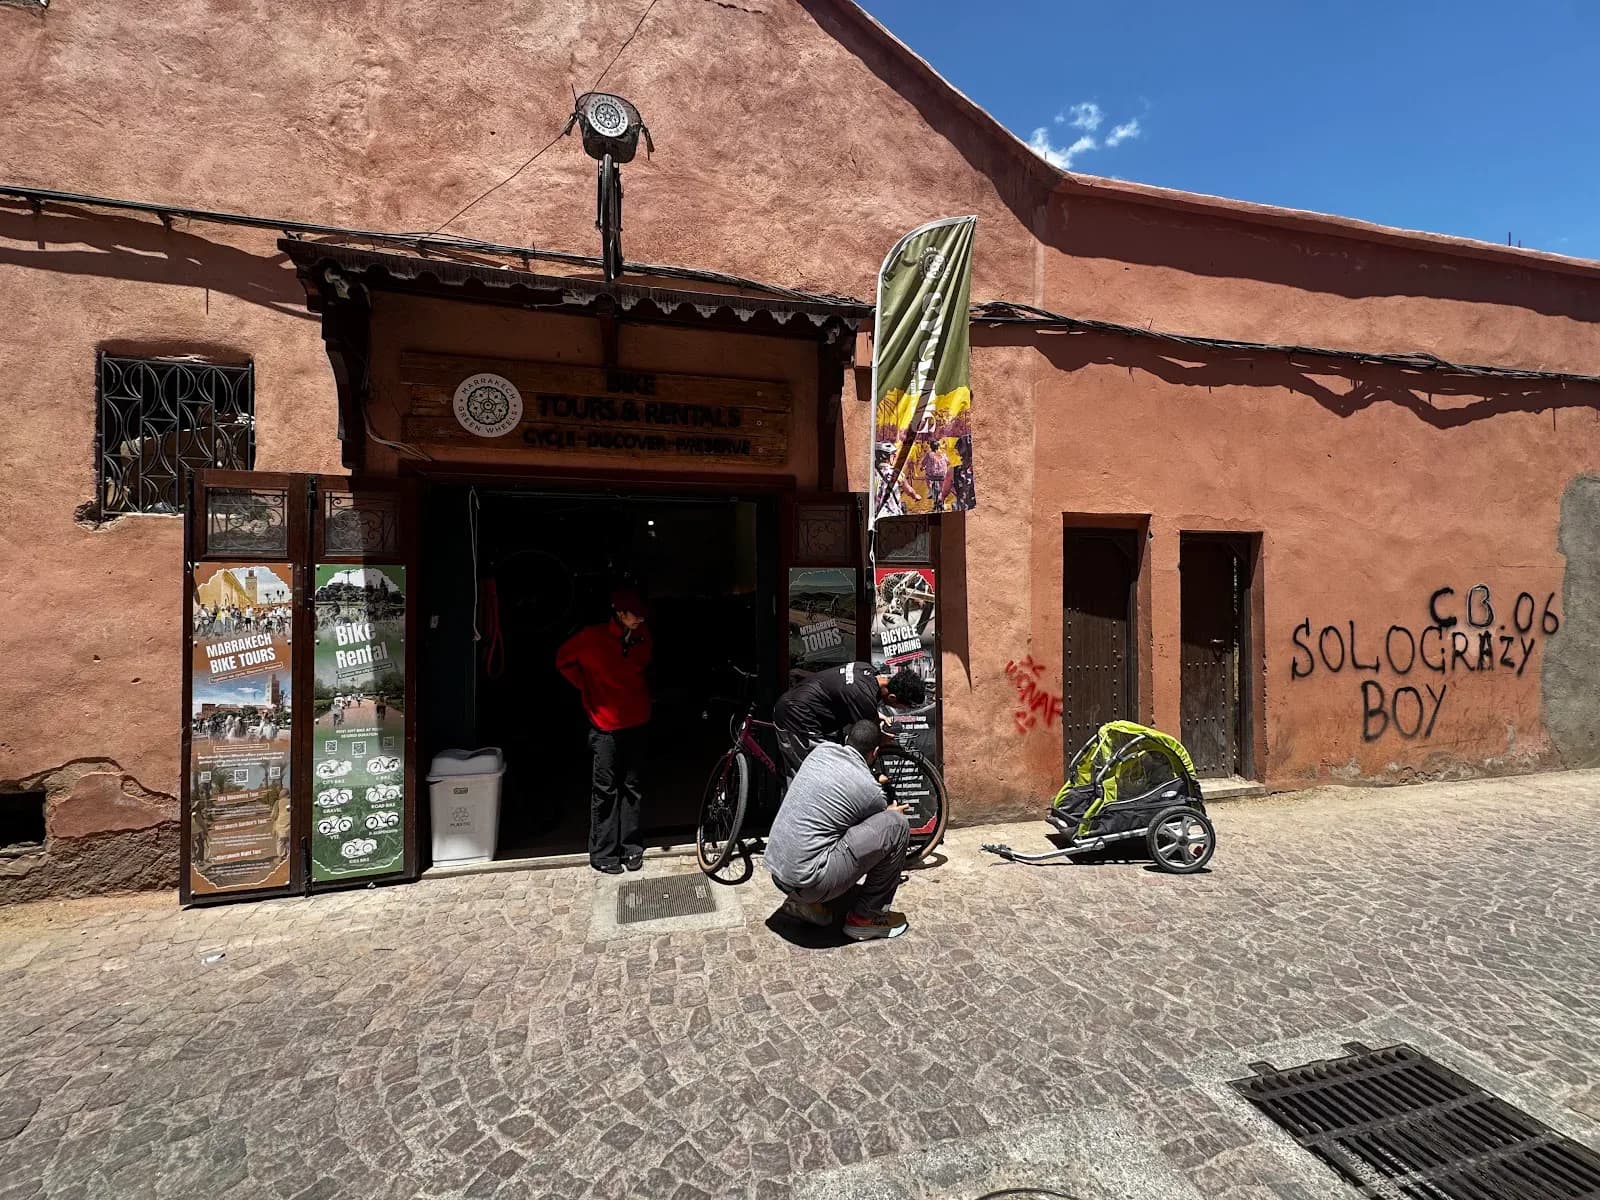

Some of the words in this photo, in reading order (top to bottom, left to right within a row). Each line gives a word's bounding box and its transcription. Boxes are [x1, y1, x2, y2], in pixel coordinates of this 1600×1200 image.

[462, 377, 515, 400] MARRAKECH
[608, 373, 655, 394] BIKE
[458, 406, 482, 432] GREEN
[485, 411, 518, 433] WHEELS
[537, 395, 617, 421] TOURS
[621, 399, 641, 422] &
[644, 401, 741, 428] RENTALS
[522, 428, 576, 448] CYCLE
[587, 431, 664, 451] DISCOVER
[676, 436, 752, 455] PRESERVE
[206, 633, 272, 657] MARRAKECH
[336, 623, 376, 646] Bike
[801, 627, 842, 653] TOURS
[880, 624, 919, 646] BICYCLE
[210, 656, 237, 673] BIKE
[238, 648, 275, 667] TOURS
[336, 642, 388, 668] Rental
[883, 638, 922, 658] REPAIRING
[1361, 679, 1448, 743] BOY
